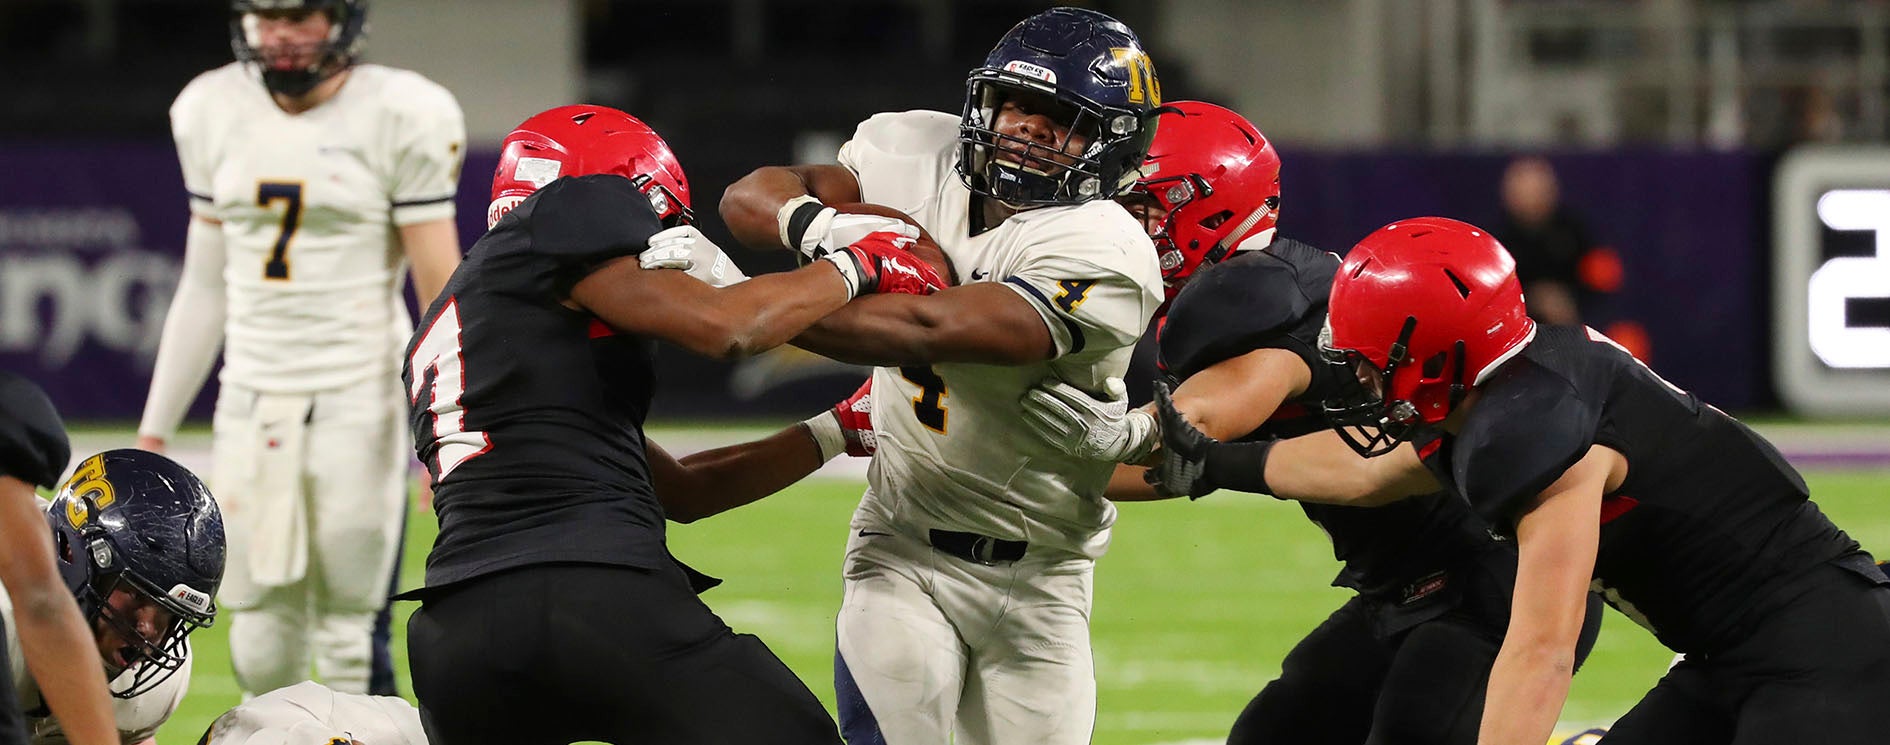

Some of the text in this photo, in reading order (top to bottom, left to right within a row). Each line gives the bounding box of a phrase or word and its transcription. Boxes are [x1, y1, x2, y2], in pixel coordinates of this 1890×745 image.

[255, 178, 304, 281] 7
[1808, 189, 1890, 368] 2
[1052, 278, 1098, 314] 4
[410, 294, 494, 483] 7
[60, 453, 116, 531] TC
